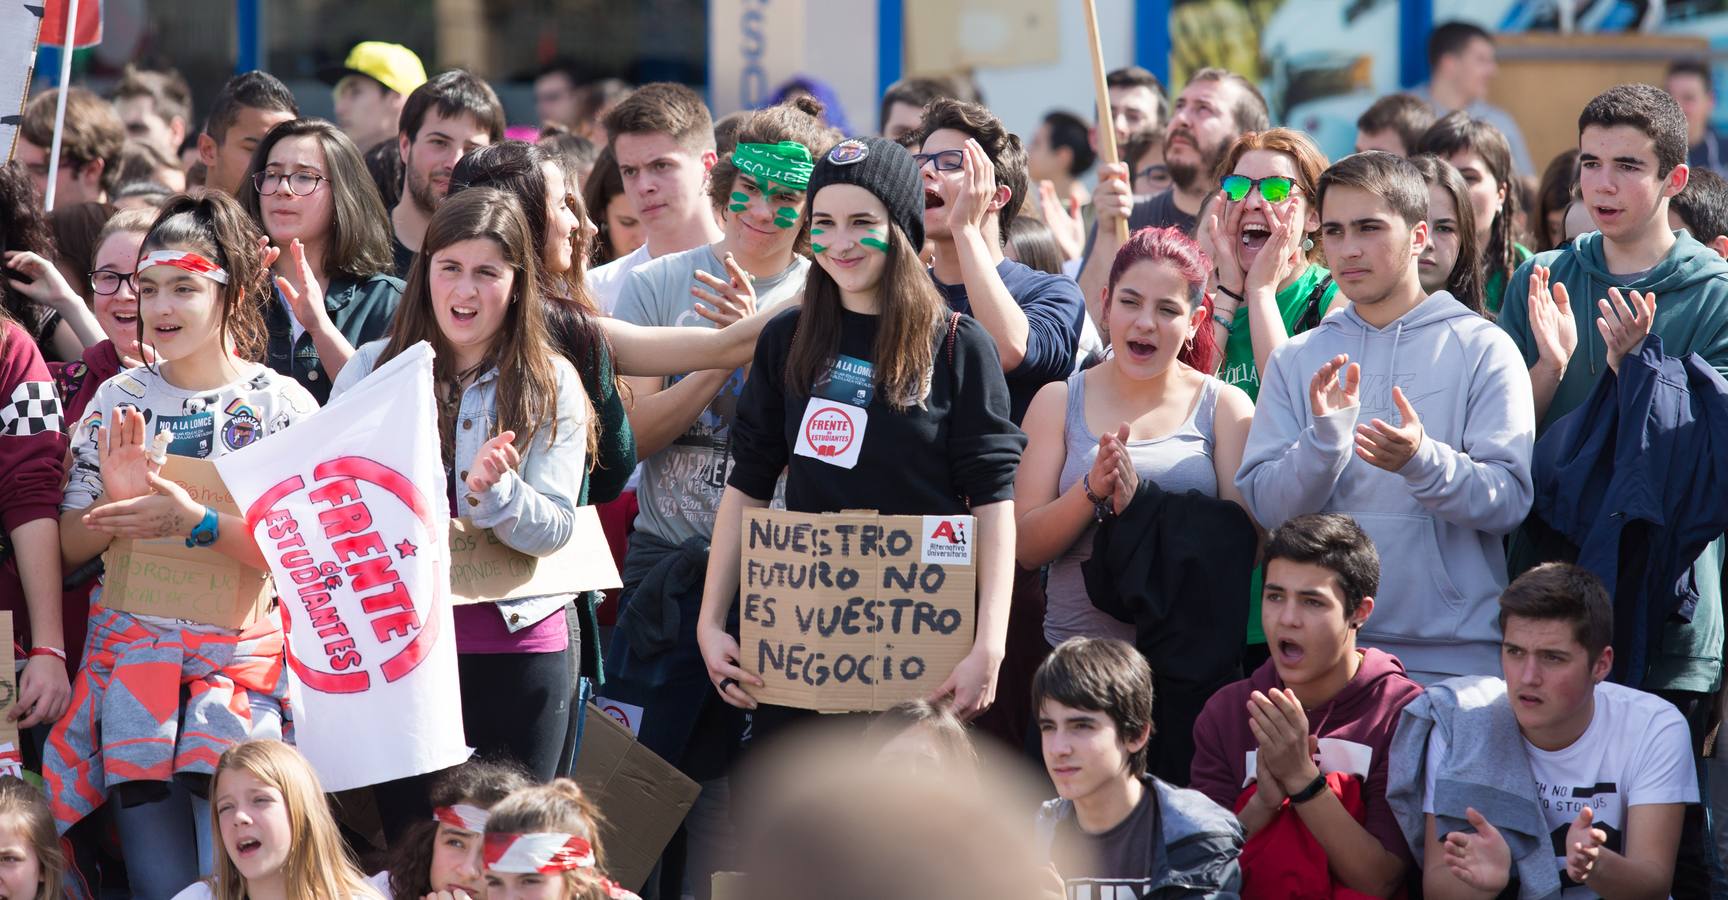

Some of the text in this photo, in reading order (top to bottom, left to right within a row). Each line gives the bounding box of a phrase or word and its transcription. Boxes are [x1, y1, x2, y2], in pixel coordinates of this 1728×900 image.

[836, 360, 842, 369] A
[842, 361, 852, 372] LA
[160, 417, 212, 431] NO A LA LOMCE
[811, 420, 849, 431] FRENTE
[811, 434, 849, 442] ESTUDIANTES
[749, 518, 912, 558] NUESTRO
[309, 477, 422, 644] FRENTE
[748, 559, 946, 594] FUTURO NO
[265, 508, 362, 671] ESTUDIANTES
[744, 594, 962, 637] ES VUESTRO
[1552, 785, 1567, 797] NO
[1593, 797, 1607, 809] US
